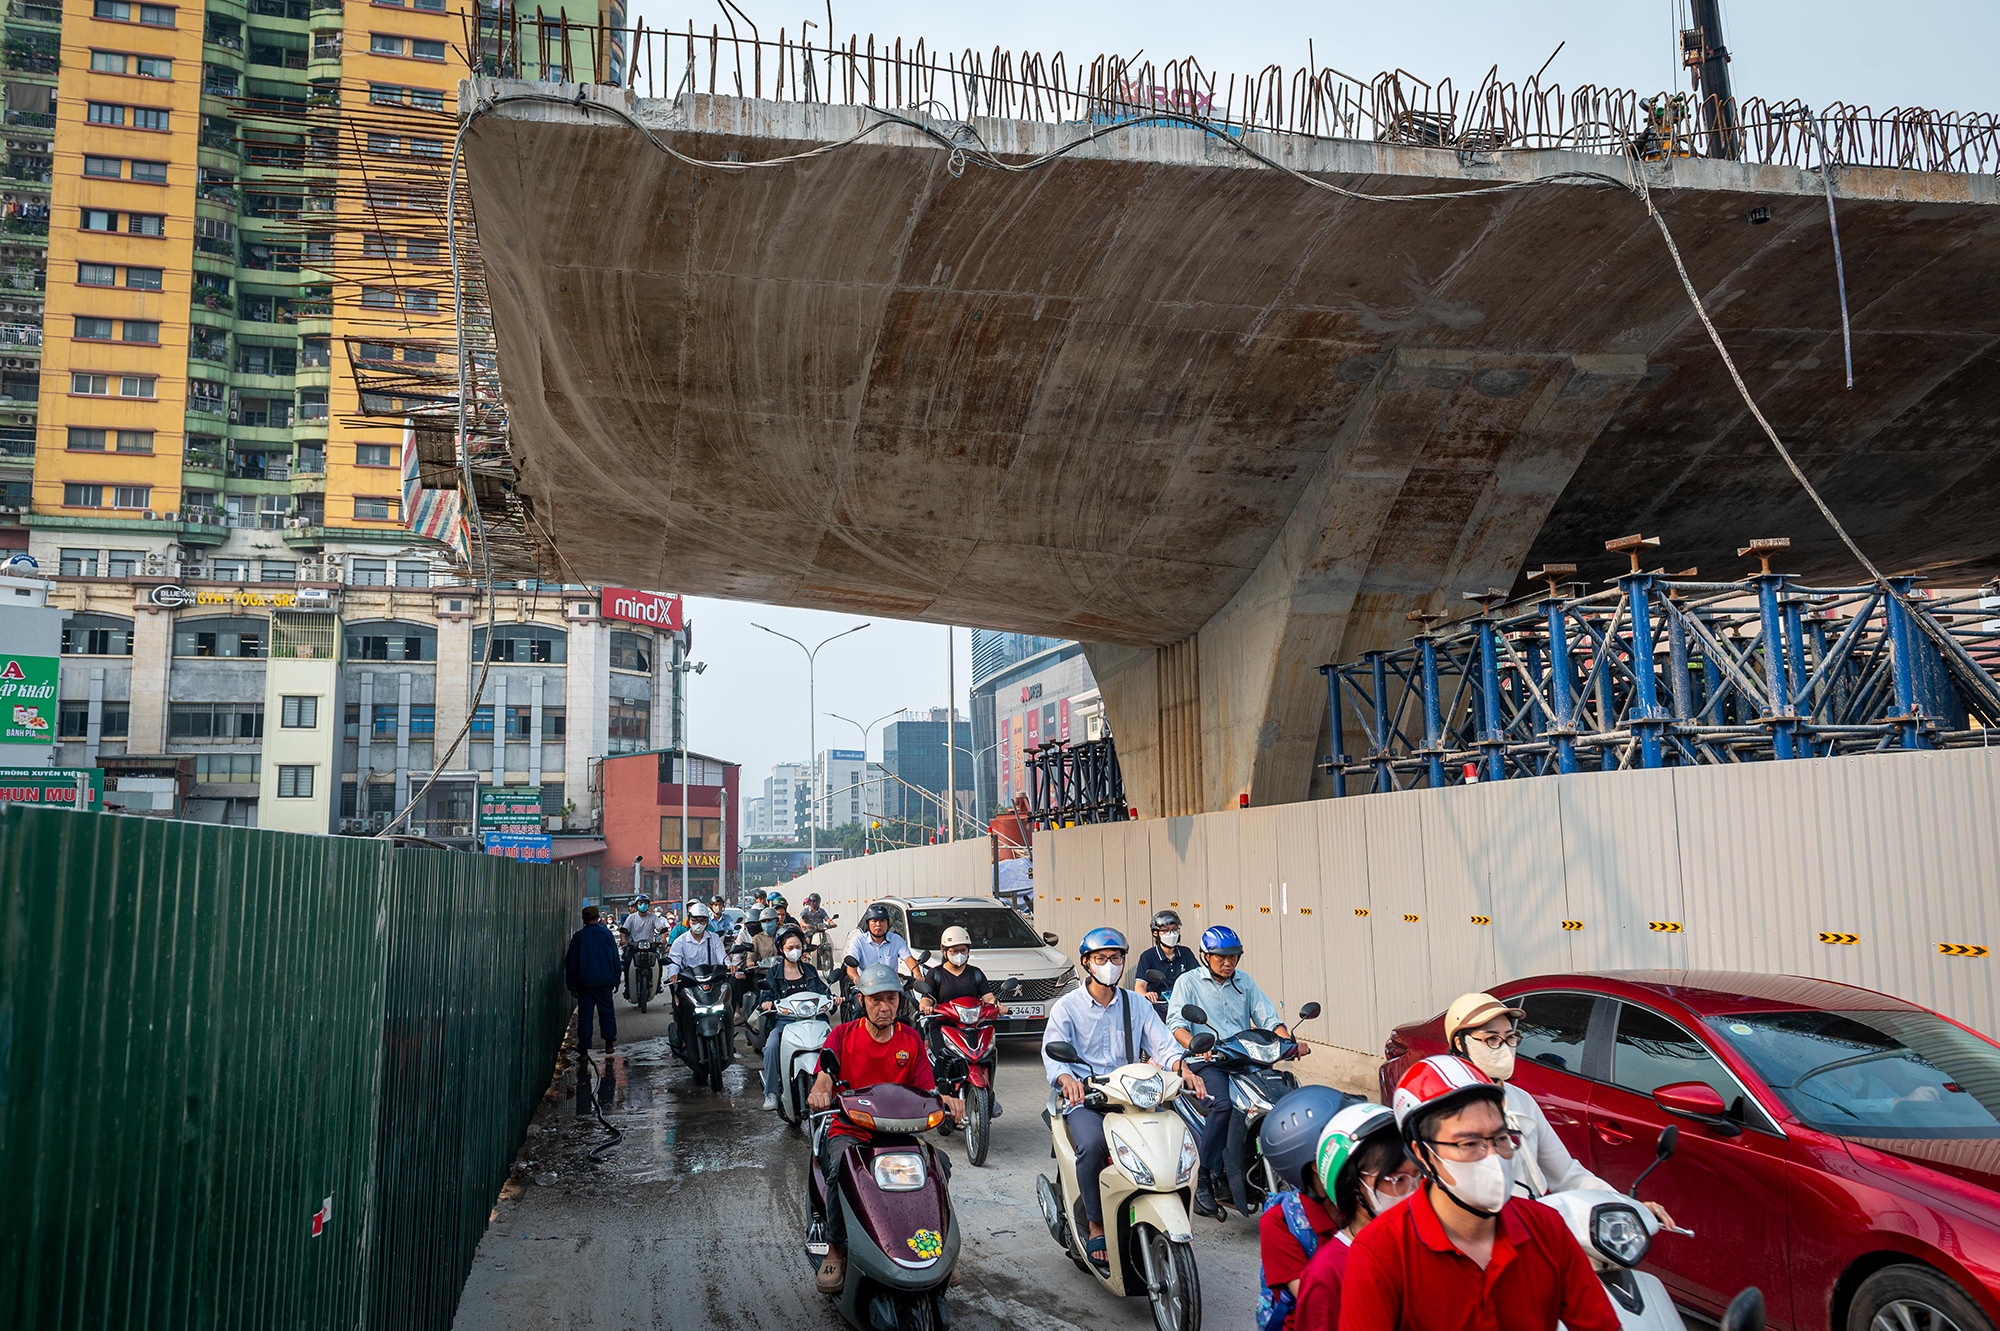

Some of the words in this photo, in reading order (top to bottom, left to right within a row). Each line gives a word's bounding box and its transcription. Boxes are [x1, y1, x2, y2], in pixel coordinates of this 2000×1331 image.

[1146, 85, 1217, 111] ROX
[161, 590, 197, 598] BLUESKY
[197, 591, 224, 606] GYM
[233, 592, 266, 607] YOGA
[615, 597, 672, 625] mindX
[17, 680, 55, 699] KHẨU
[6, 728, 24, 737] BÁNH
[45, 787, 95, 802] MUI
[521, 845, 535, 861] TẬN
[536, 844, 550, 859] GỐC
